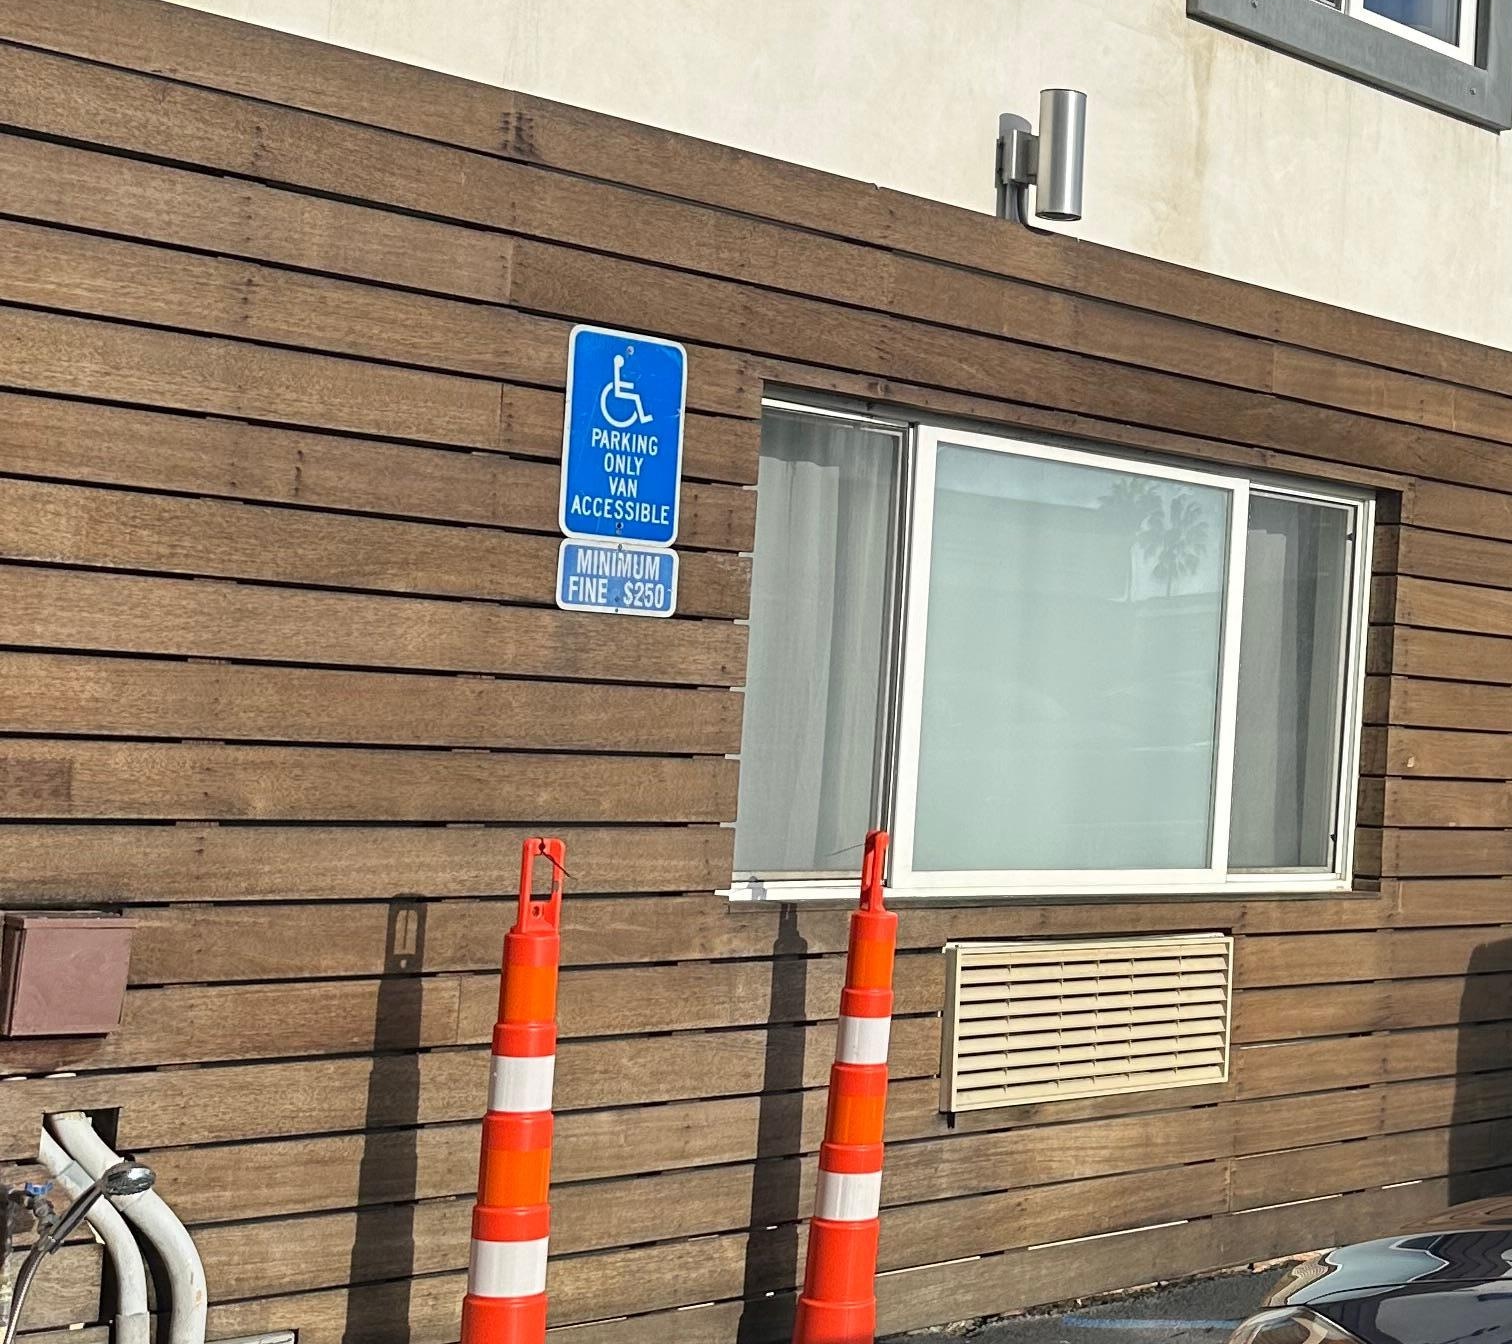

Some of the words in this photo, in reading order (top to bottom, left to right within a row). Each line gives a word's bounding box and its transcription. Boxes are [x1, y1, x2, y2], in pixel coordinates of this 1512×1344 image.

[592, 428, 658, 456] PARKING
[604, 453, 643, 476] ONLY
[609, 476, 638, 498] VAN
[571, 495, 670, 525] ACCESSIBLE
[577, 549, 660, 580] MINIMUM
[568, 576, 608, 603] FINE
[623, 580, 664, 608] $250
